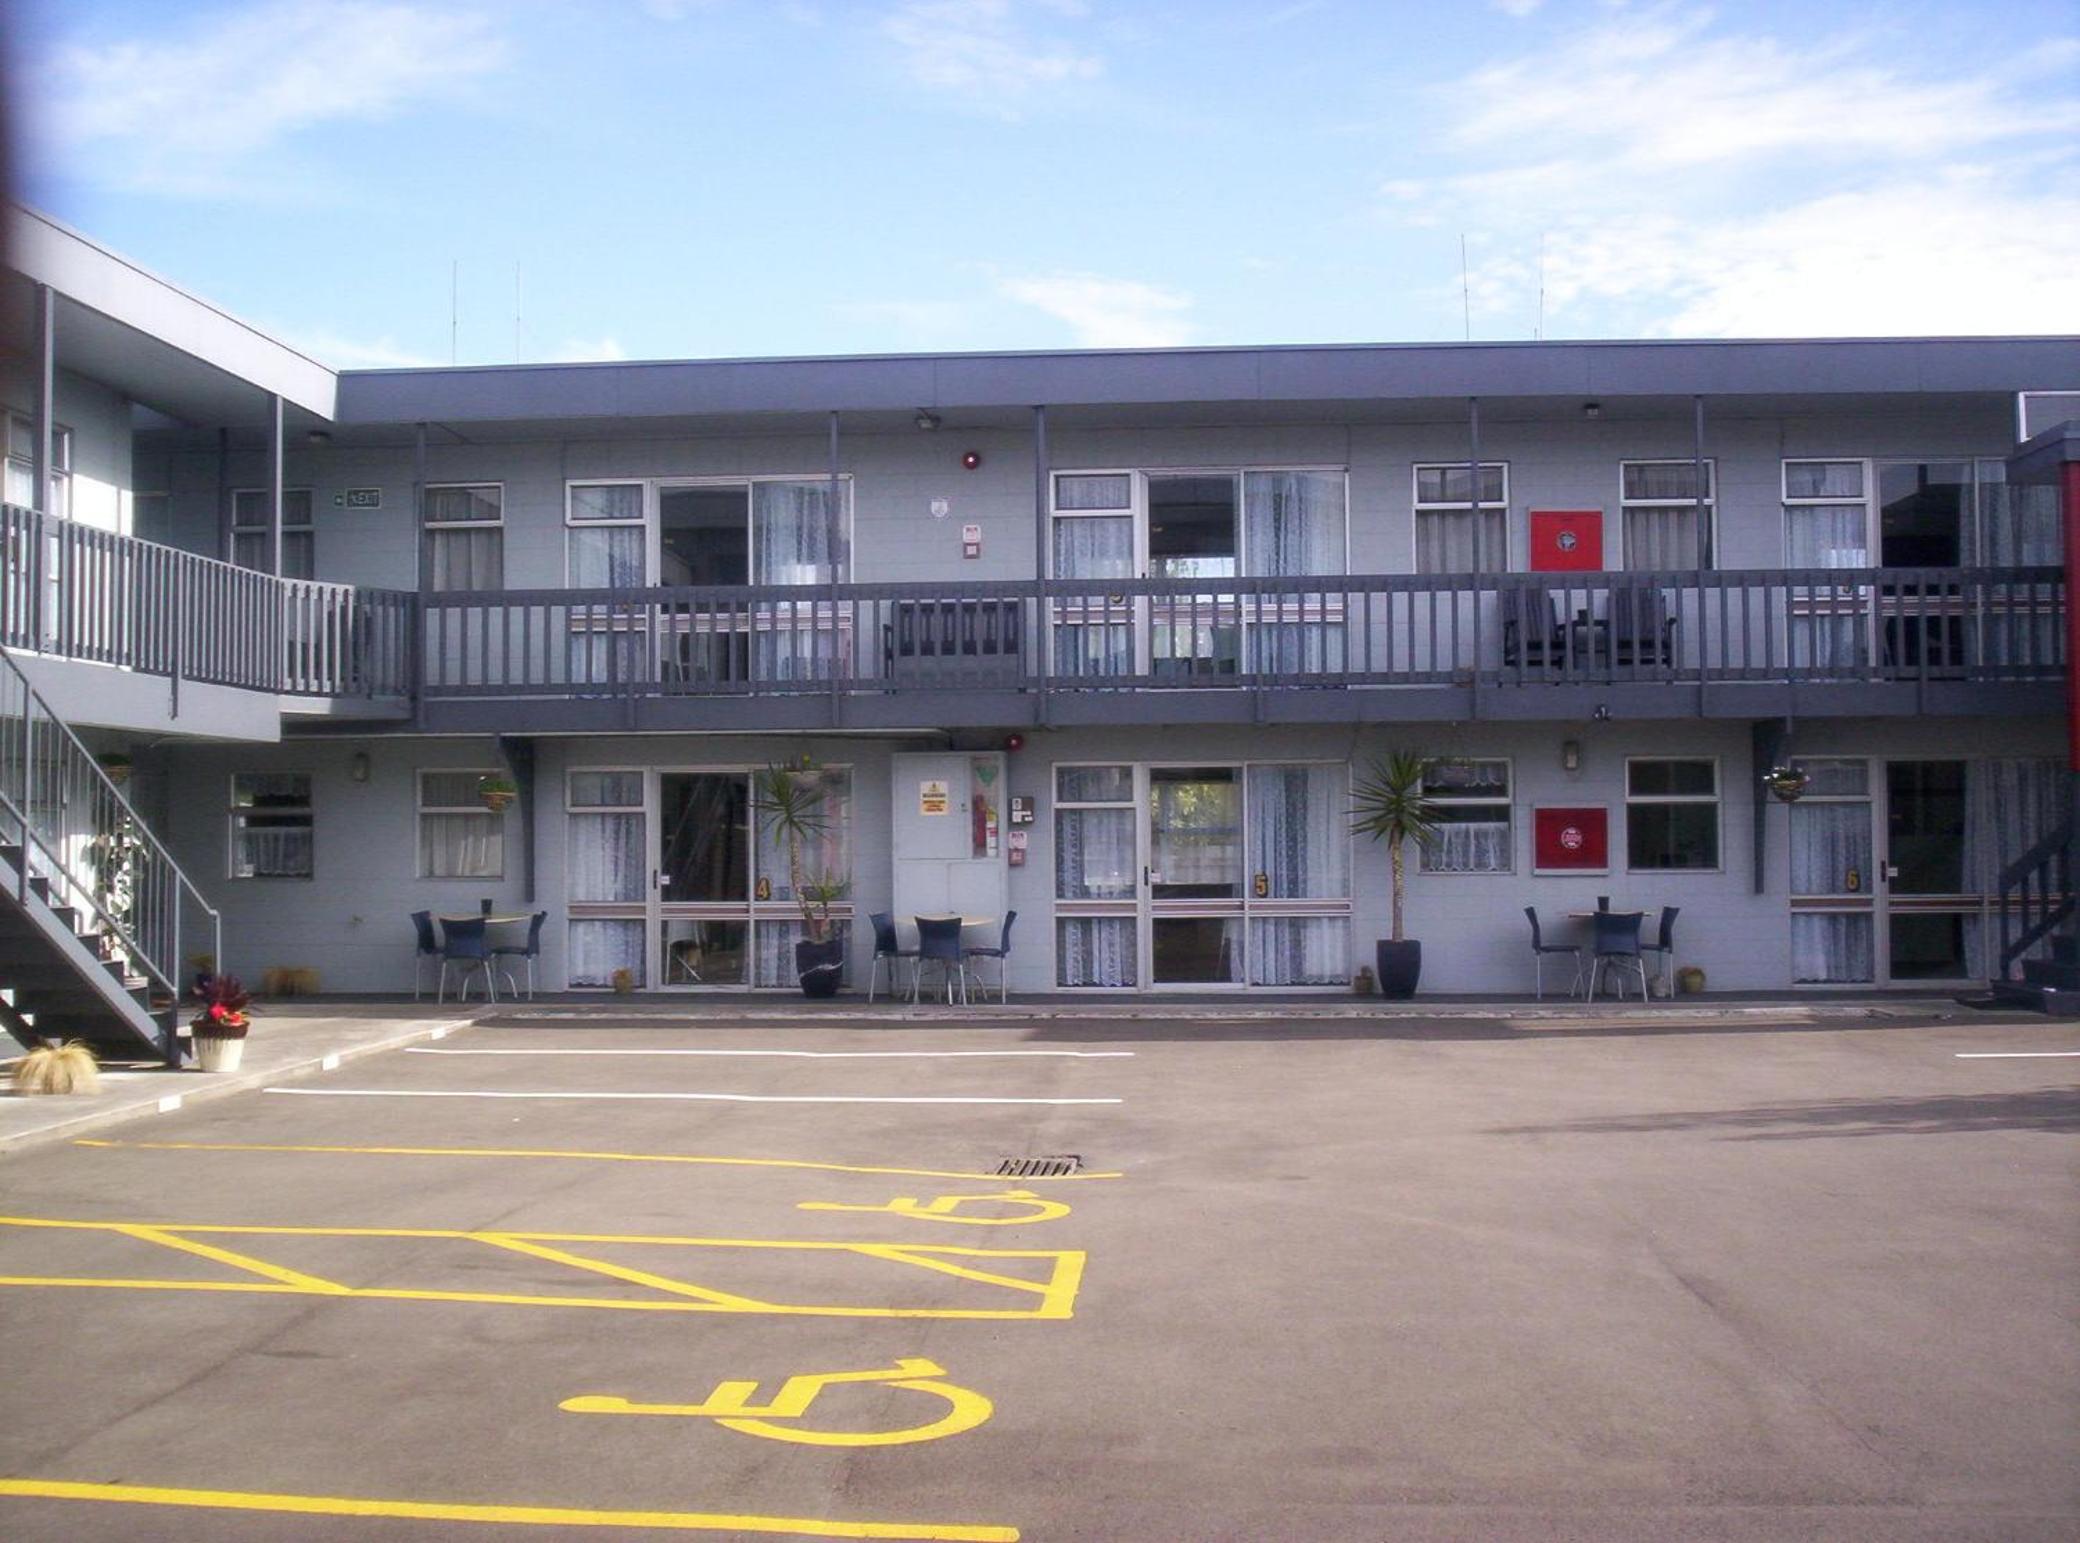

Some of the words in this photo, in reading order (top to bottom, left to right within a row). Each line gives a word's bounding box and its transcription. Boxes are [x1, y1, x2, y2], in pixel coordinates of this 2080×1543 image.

[757, 878, 769, 900] 4
[1256, 874, 1267, 896] 5
[1847, 869, 1859, 890] 6
